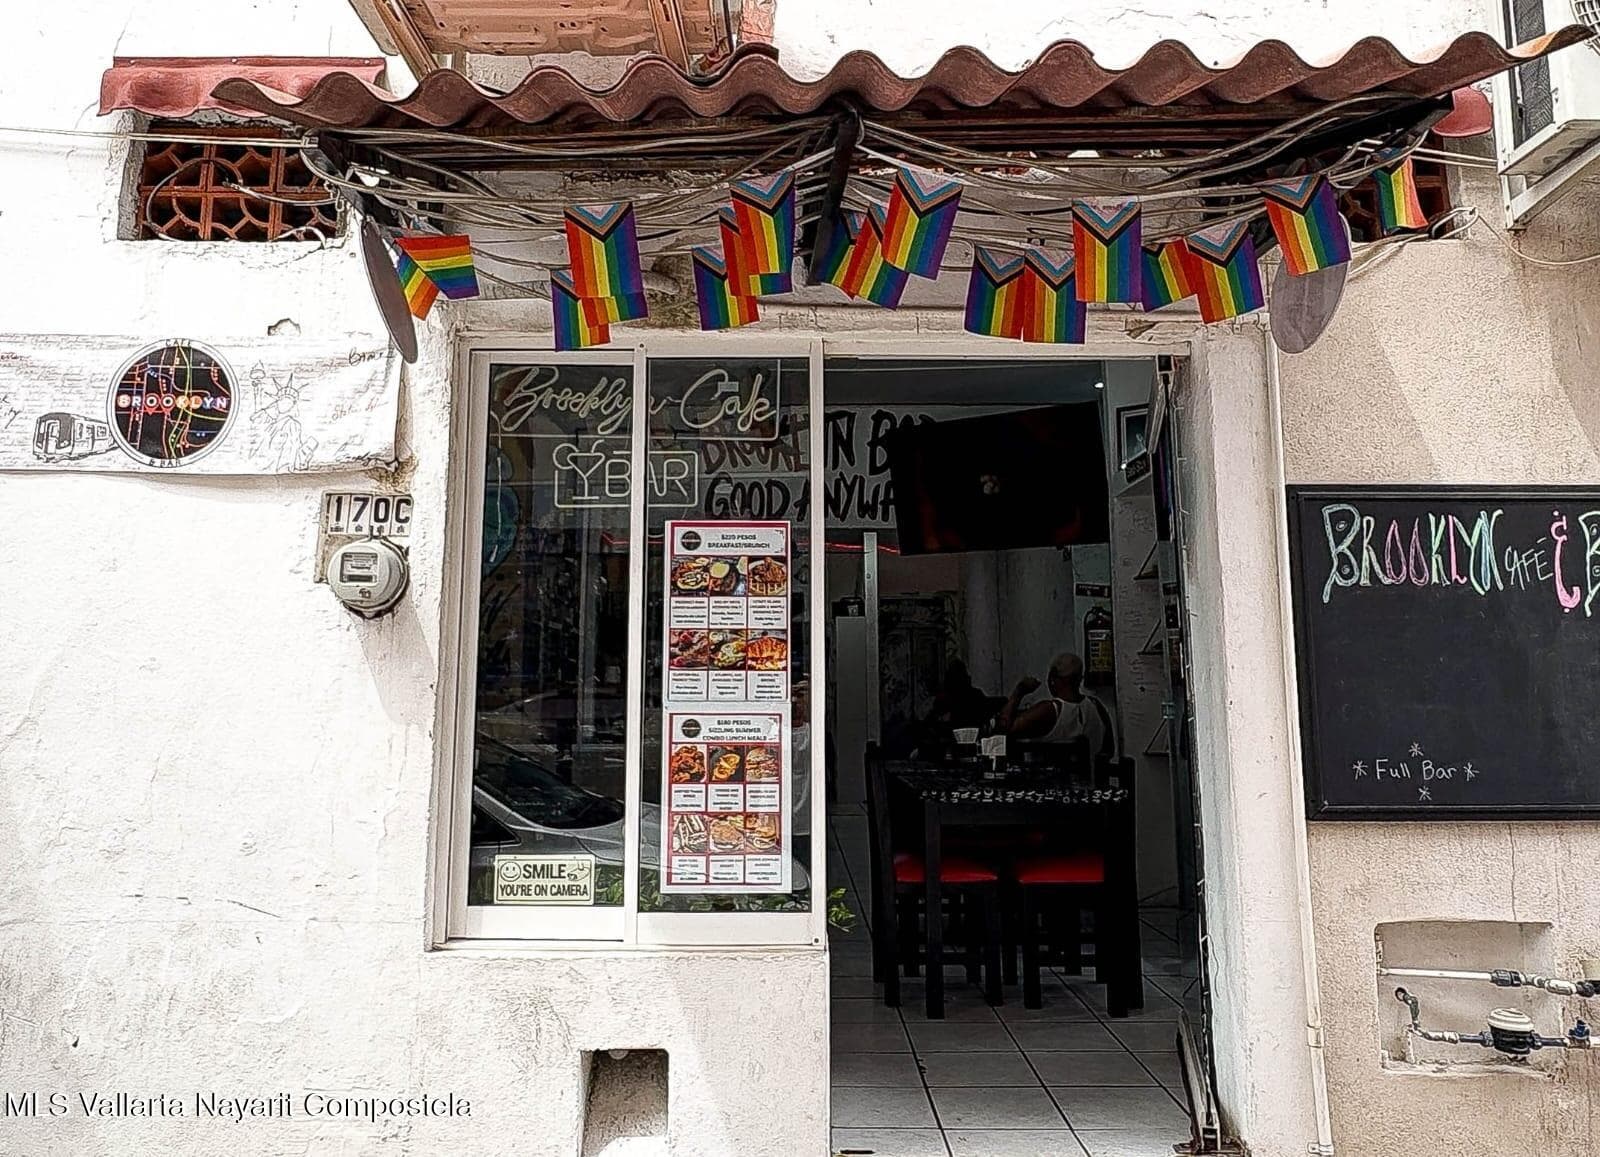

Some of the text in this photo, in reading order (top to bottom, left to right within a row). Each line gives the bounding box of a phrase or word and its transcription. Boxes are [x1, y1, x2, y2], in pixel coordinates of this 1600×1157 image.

[117, 393, 229, 415] BROOKLYN
[705, 474, 791, 519] GOOD
[334, 496, 412, 523] 170C
[1322, 503, 1504, 603] BROOKLYN
[1375, 759, 1457, 780] Full Bar
[522, 864, 567, 879] SMILE
[500, 884, 588, 897] YOU'RE ON CAMERA
